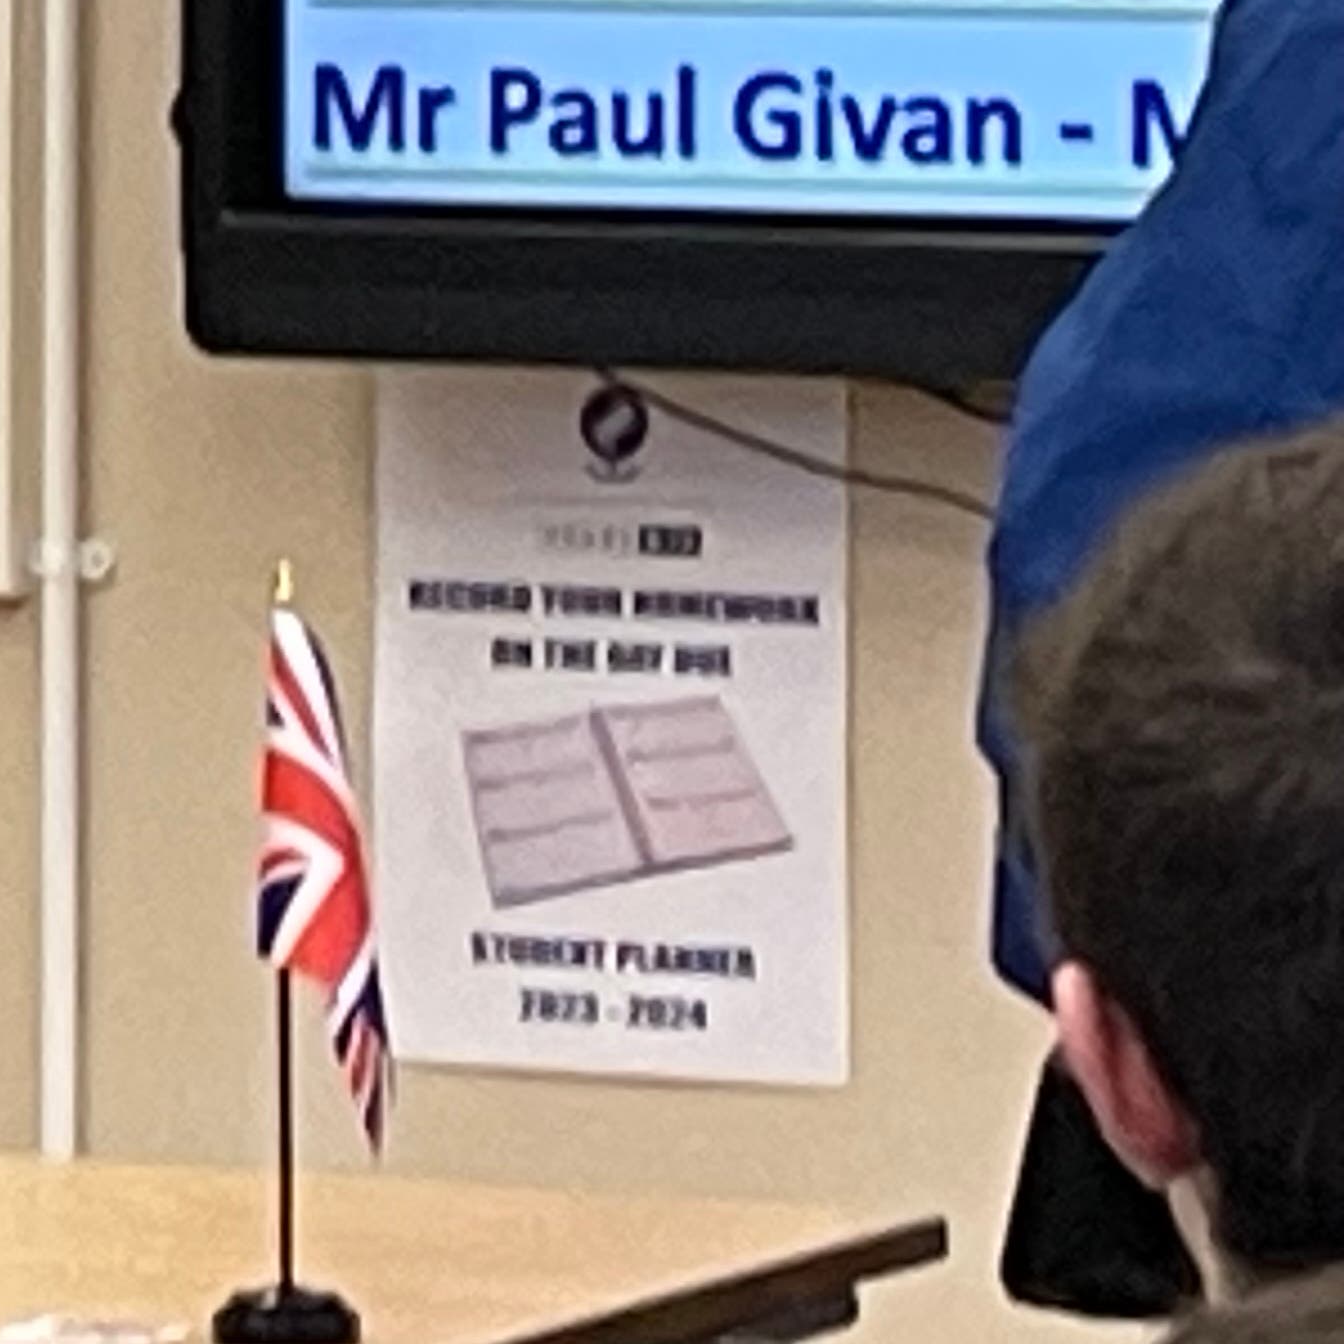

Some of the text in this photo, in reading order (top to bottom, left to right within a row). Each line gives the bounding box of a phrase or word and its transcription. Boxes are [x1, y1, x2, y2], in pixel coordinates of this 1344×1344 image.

[314, 62, 456, 154] Mr
[489, 65, 697, 160] Paul
[733, 67, 1023, 167] Givan
[1059, 121, 1094, 143] -
[632, 588, 820, 629] HOMEWORK
[470, 930, 757, 982] STUDENT PLANNER
[518, 986, 601, 1024] 2023
[625, 991, 709, 1032] 2024
